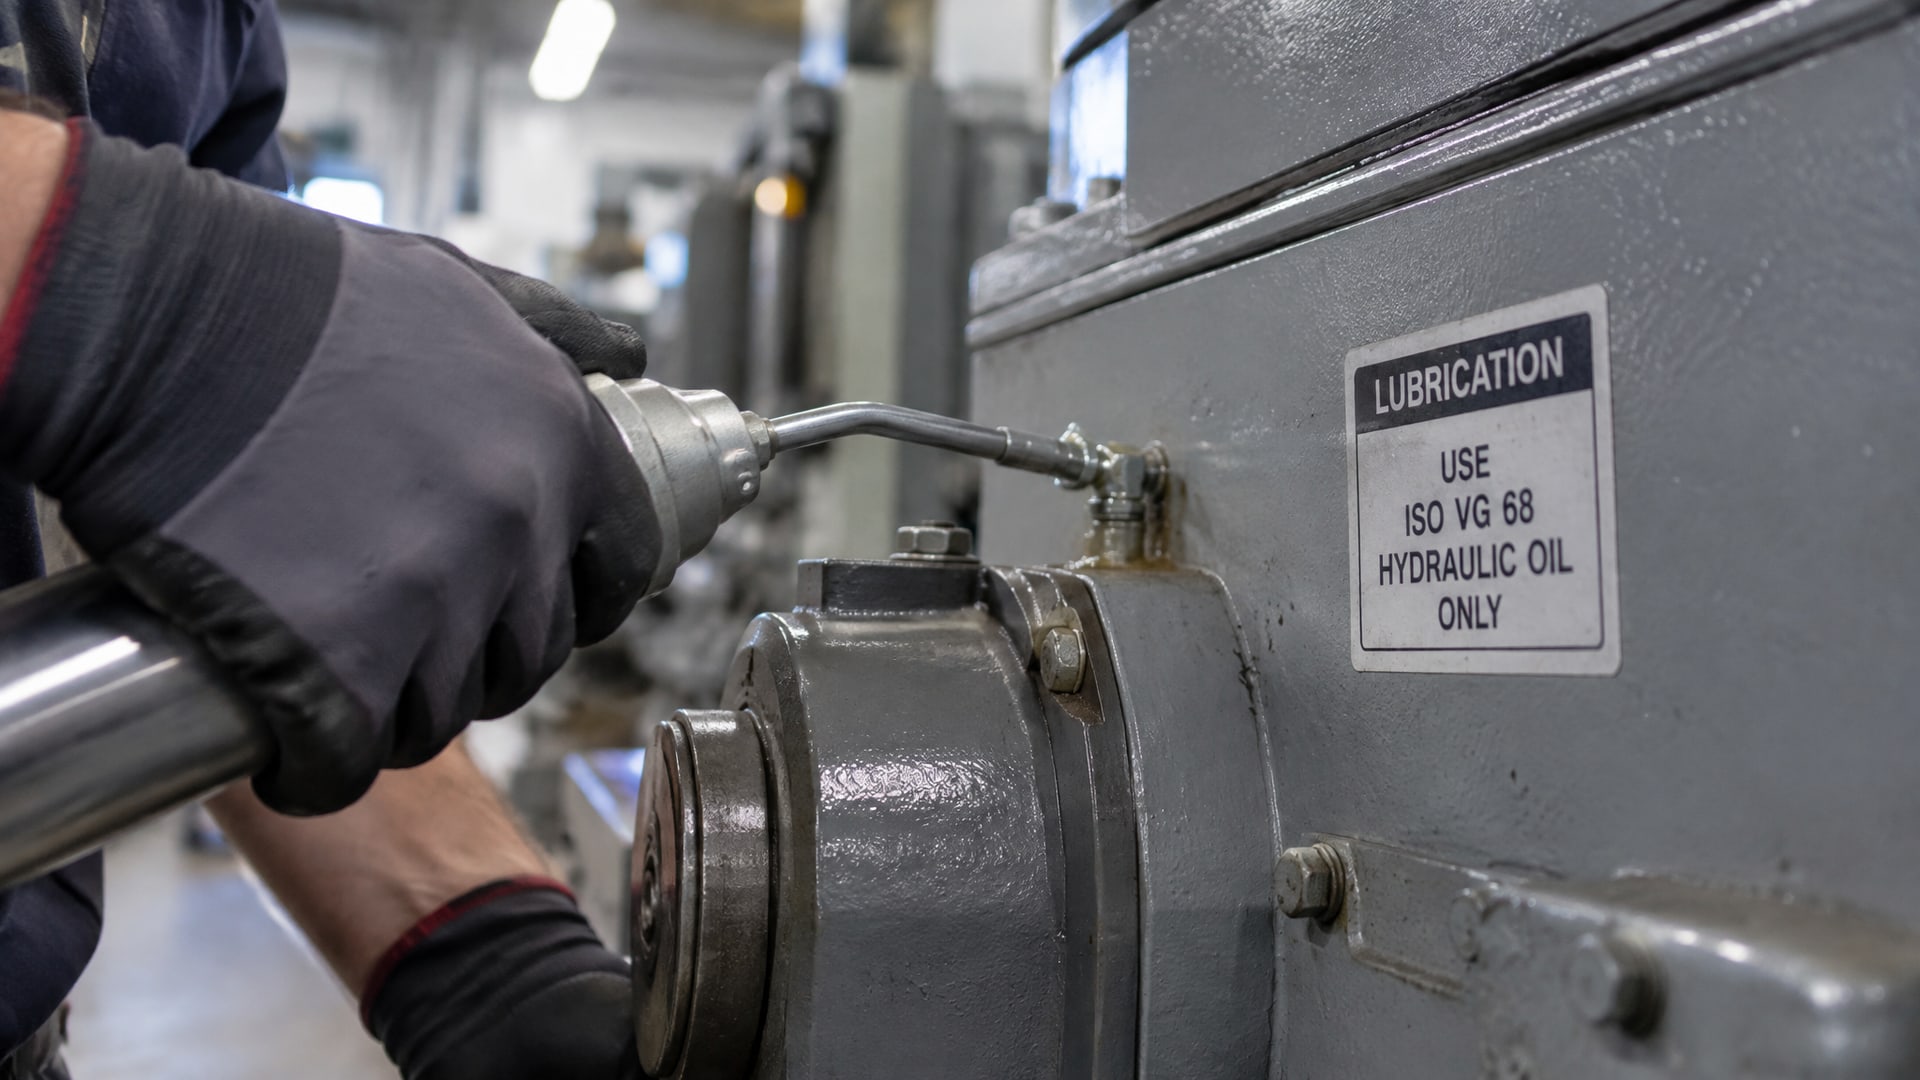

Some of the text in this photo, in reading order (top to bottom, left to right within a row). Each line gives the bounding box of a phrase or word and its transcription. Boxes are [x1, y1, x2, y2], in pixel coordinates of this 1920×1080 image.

[1375, 336, 1563, 415] LUBRICATION
[1441, 444, 1490, 483] USE
[1405, 488, 1534, 536] ISO VG 68
[1379, 537, 1573, 585] HYDRAULIC OIL
[1438, 594, 1502, 630] ONLY
